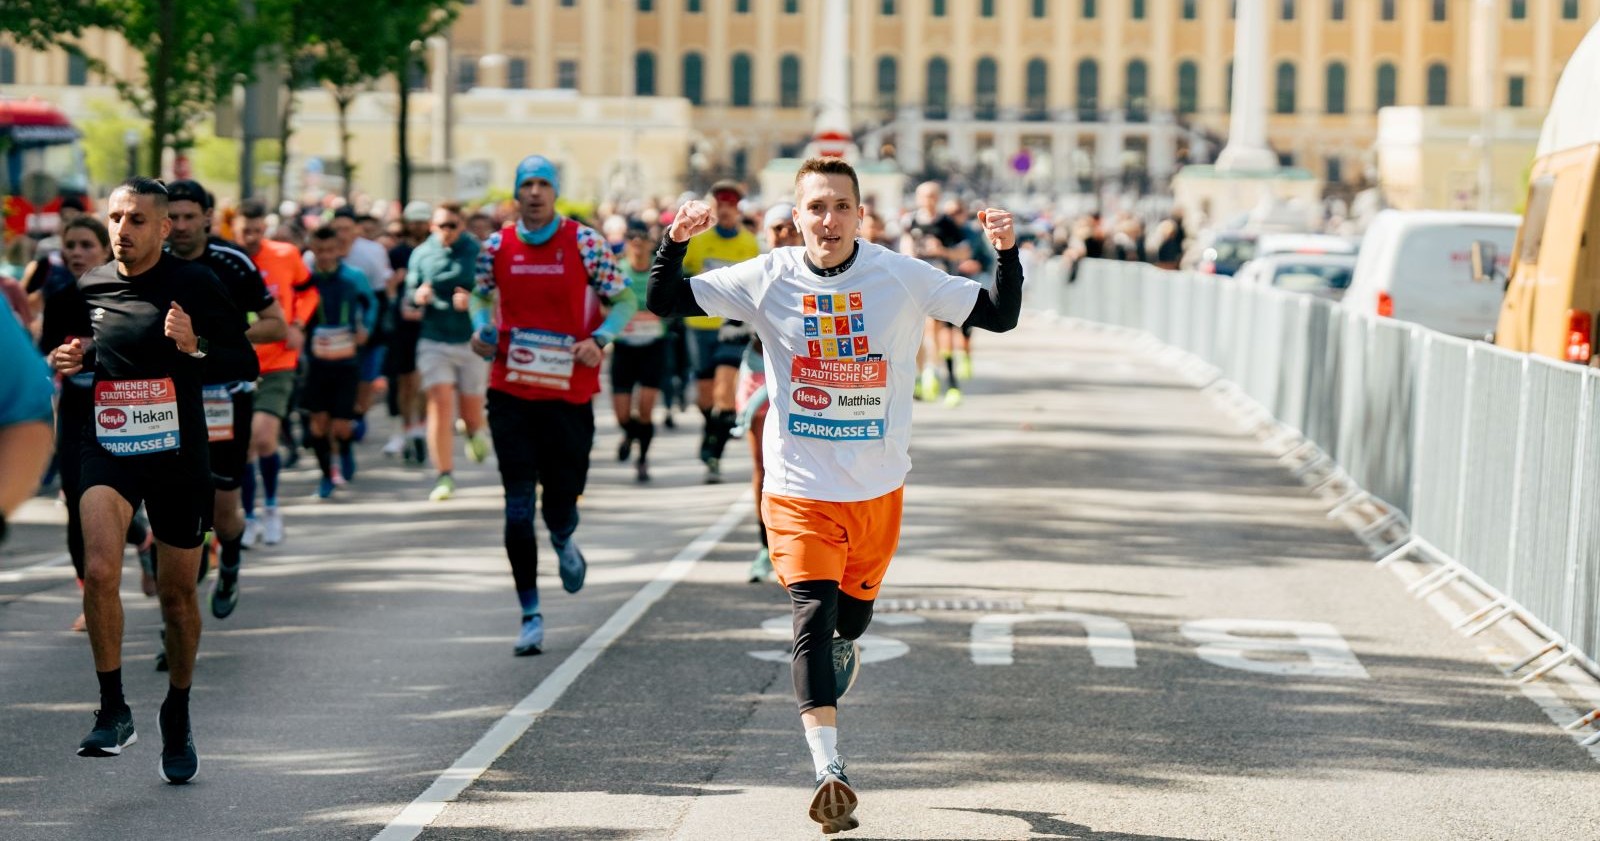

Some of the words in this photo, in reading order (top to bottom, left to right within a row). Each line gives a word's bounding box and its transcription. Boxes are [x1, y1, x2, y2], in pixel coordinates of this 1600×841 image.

[820, 361, 861, 372] WIENER
[800, 367, 860, 382] STÄDTISCHE
[113, 381, 149, 391] WIENER
[796, 390, 829, 406] Hervis
[838, 394, 881, 407] Matthias
[100, 412, 125, 425] Hervis
[133, 409, 174, 424] Hakan
[206, 407, 230, 418] dam
[793, 421, 865, 437] SPARKASSE
[746, 611, 1371, 678] BUS
